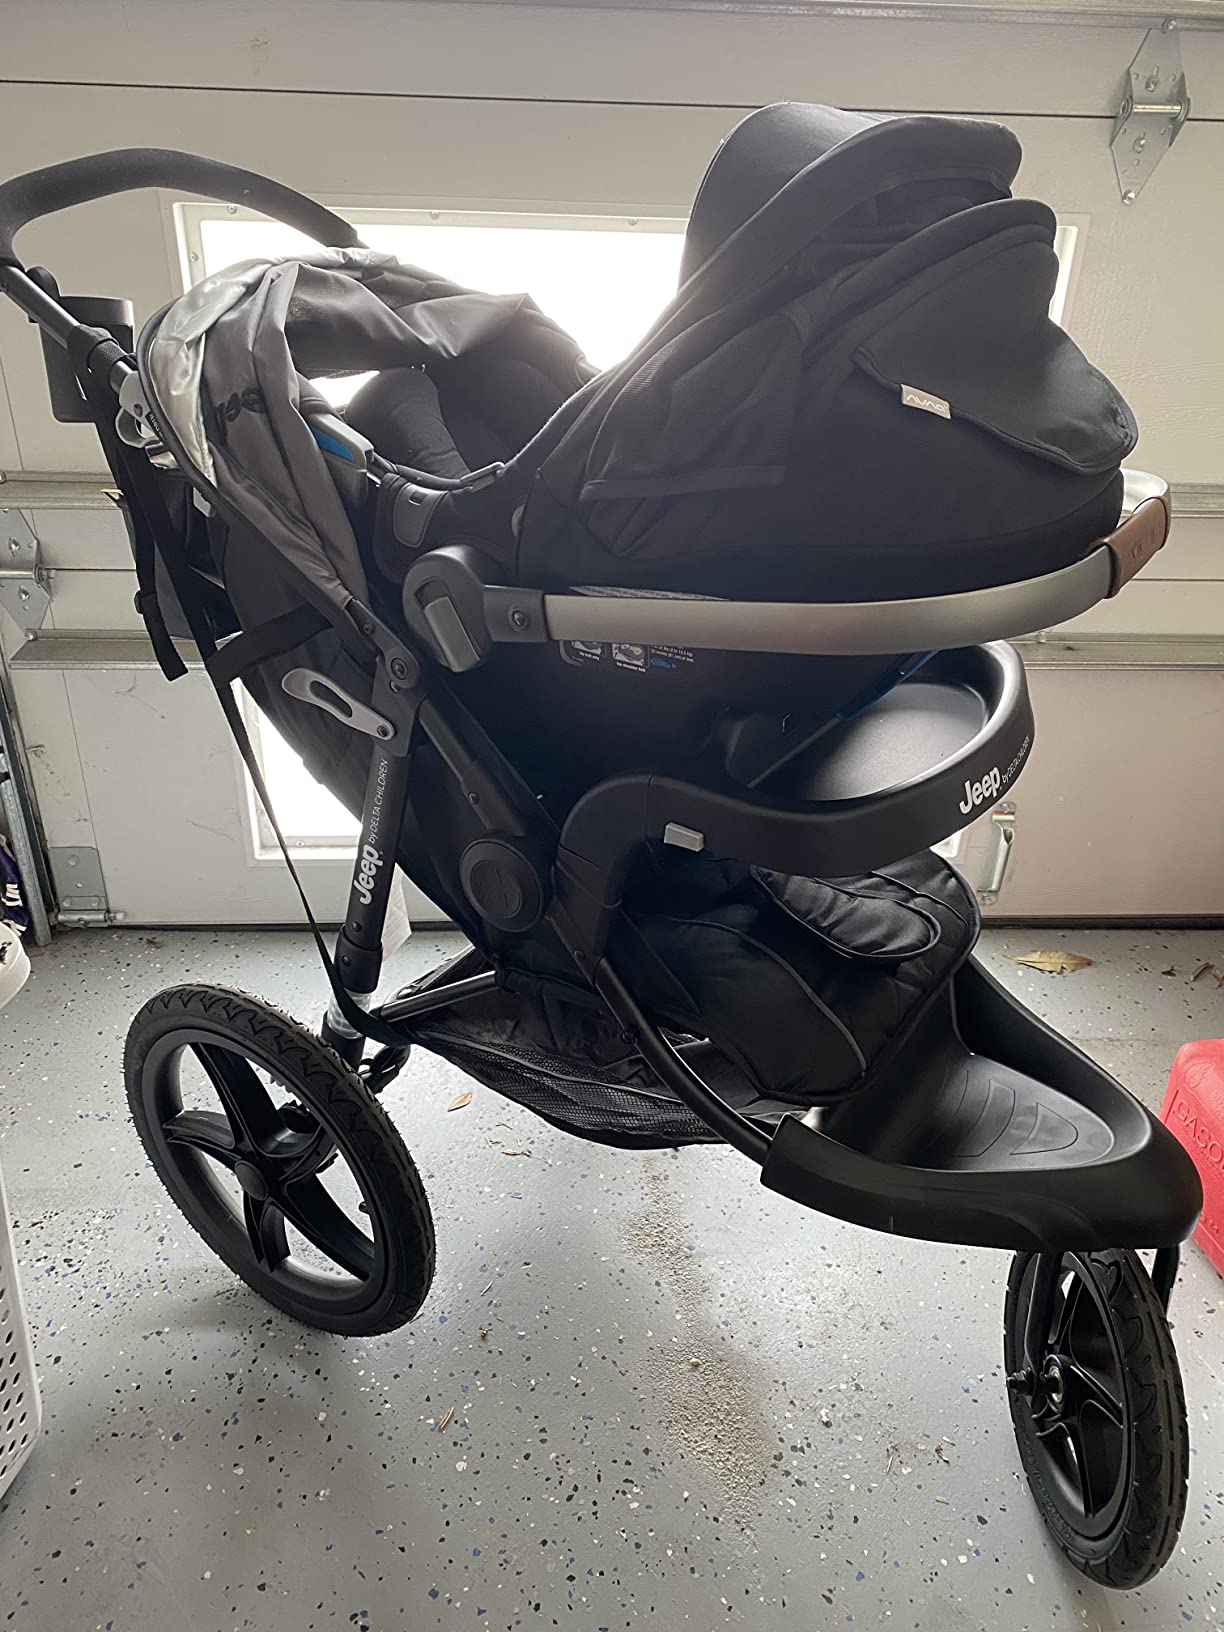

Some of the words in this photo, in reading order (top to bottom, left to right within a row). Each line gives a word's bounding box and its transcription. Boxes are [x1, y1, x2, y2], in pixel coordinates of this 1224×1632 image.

[374, 758, 389, 806] CHILDREN
[959, 766, 1001, 815] Jeep
[1001, 774, 1010, 783] by
[368, 831, 379, 844] by
[369, 806, 381, 832] DELTA
[353, 844, 384, 905] Jeep
[1178, 1101, 1224, 1170] GASO
